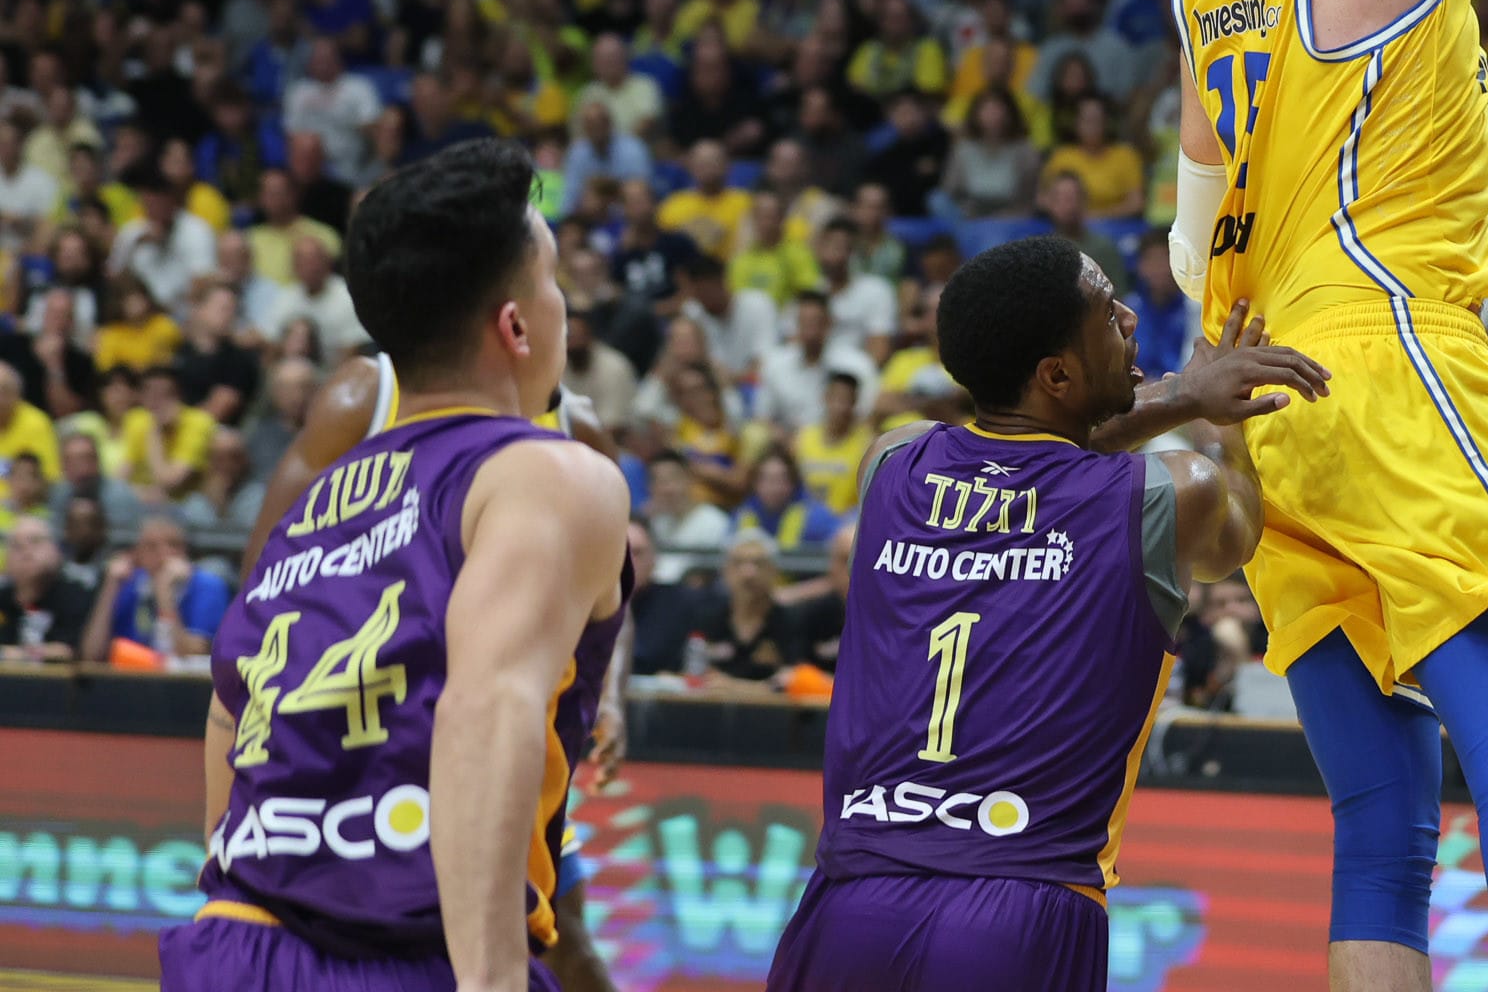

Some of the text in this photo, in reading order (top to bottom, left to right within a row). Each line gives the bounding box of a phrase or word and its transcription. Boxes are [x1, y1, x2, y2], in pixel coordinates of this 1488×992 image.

[246, 507, 414, 605] AUTO CENTER
[874, 539, 1066, 581] AUTO CENTER
[235, 580, 407, 768] 14
[918, 611, 980, 763] 1
